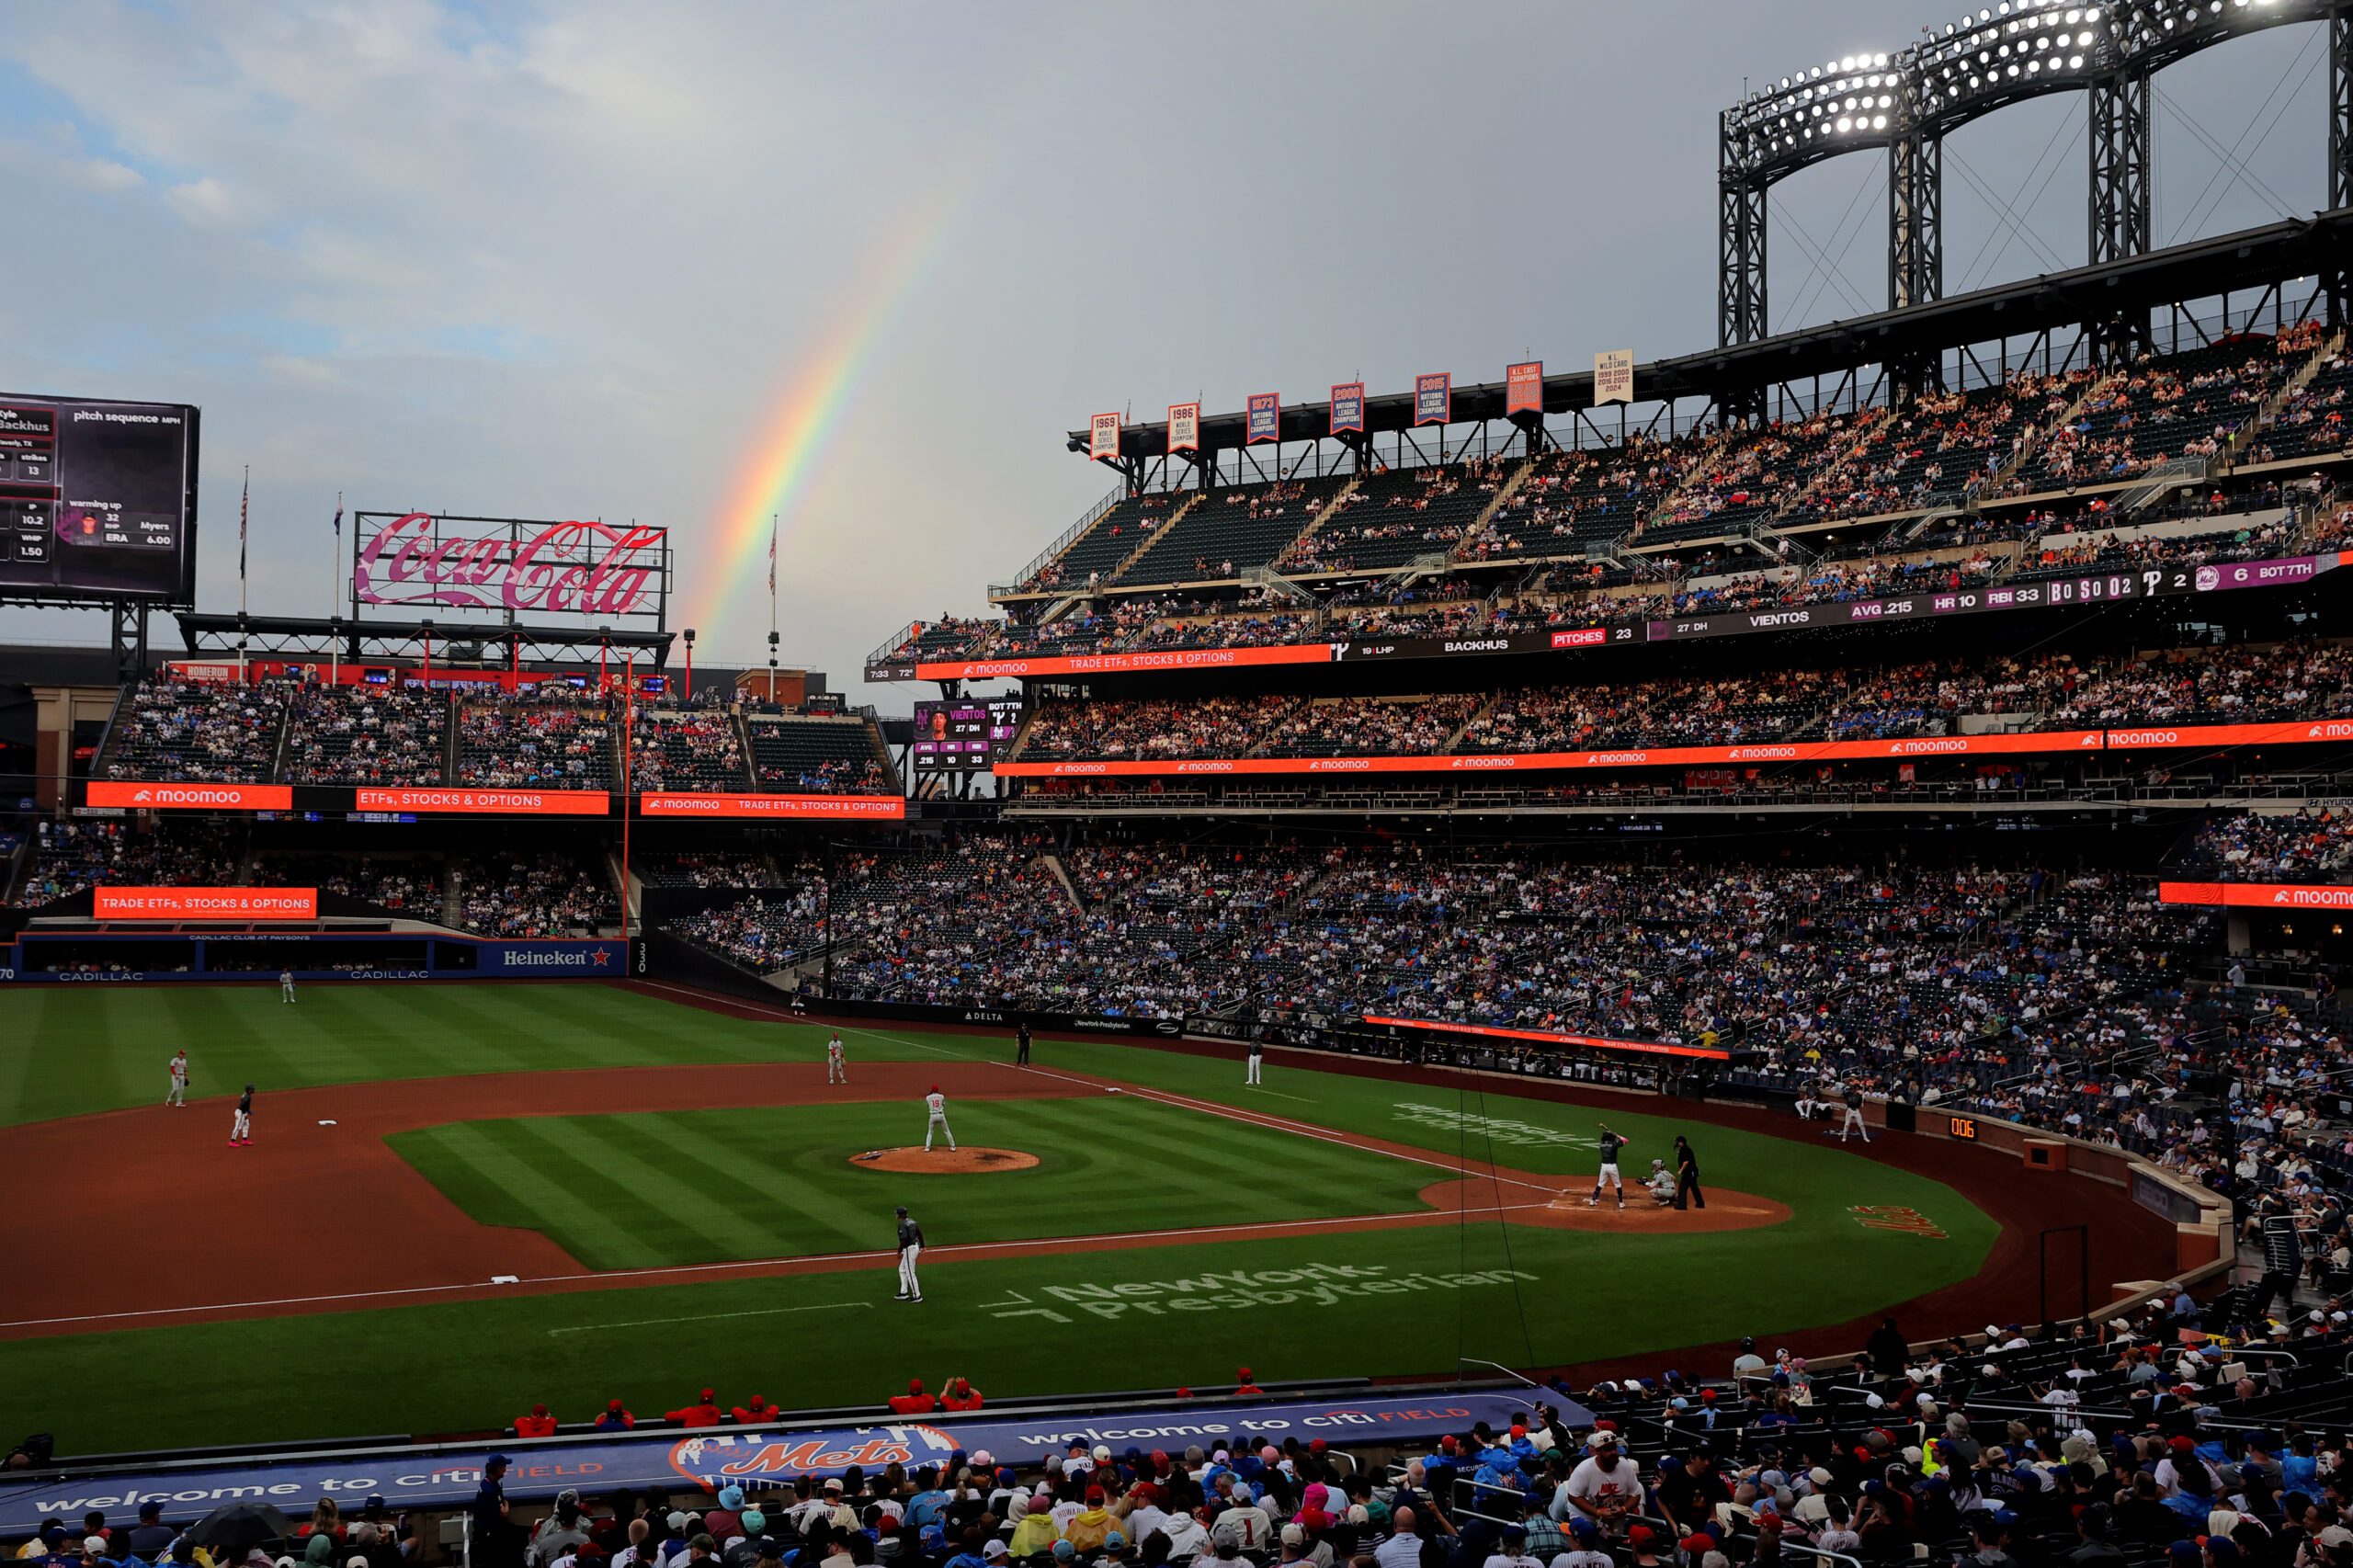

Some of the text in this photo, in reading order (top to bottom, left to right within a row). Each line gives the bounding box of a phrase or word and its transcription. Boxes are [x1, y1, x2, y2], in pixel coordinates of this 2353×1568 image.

[1421, 377, 1445, 392] 2015
[1335, 387, 1360, 401] 2000
[1252, 397, 1274, 410] 1973
[74, 410, 103, 422] pitch
[105, 414, 159, 424] sequence
[1173, 408, 1193, 419] 1986
[1096, 417, 1115, 428] 1969
[28, 466, 40, 475] 13
[70, 500, 122, 511] warming up
[22, 515, 44, 526] 10.2
[107, 513, 119, 522] 32
[141, 521, 169, 531] Myers
[22, 534, 42, 542] WHIP
[106, 533, 171, 544] ERA 6.00
[20, 546, 42, 556] 1.50
[355, 512, 669, 613] Coca-Cola
[2234, 568, 2248, 581] 6
[2259, 563, 2313, 579] BOT 7TH
[2173, 574, 2187, 588] 2
[1934, 596, 1976, 608] HR 10
[1988, 588, 2040, 605] RBI 33
[1851, 601, 1913, 618] AVG .215
[1750, 612, 1809, 627] VIENTOS
[1677, 621, 1708, 632] 27 DH
[1554, 631, 1604, 645] PITCHES
[1616, 629, 1632, 640] 23
[1375, 645, 1395, 654] LHP
[1445, 640, 1509, 653] BACKHUS
[1070, 653, 1234, 669] TRADE ETFs, STOCKS & OPTIONS
[188, 665, 228, 676] HOMERUN
[870, 669, 890, 678] 7:33
[977, 662, 1028, 675] moomoo
[989, 702, 1005, 710] BOT
[950, 710, 985, 720] VIENTOS
[956, 724, 965, 733] 27
[2327, 723, 2353, 737] mo
[2100, 732, 2177, 744] moomoo
[1743, 746, 1796, 758] moomoo
[1906, 740, 1967, 753] moomoo
[1322, 759, 1370, 768] moomoo
[1465, 757, 1515, 767] moomoo
[1599, 752, 1646, 763] moomoo
[1064, 765, 1106, 774] moomoo
[1188, 762, 1233, 771] moomoo
[156, 790, 241, 803] moomoo
[360, 792, 542, 807] ETFs, STOCKS & OPTIONS
[664, 800, 720, 810] moomoo
[739, 801, 897, 812] TRADE ETFs, STOCKS & OPTIONS
[103, 898, 311, 910] TRADE ETFs, STOCKS & OPTIONS
[504, 950, 585, 966] Heineken
[59, 972, 143, 982] CADILLAC
[351, 971, 428, 979] CADILLAC
[974, 1012, 1003, 1022] DELTA
[1952, 1118, 1974, 1138] 006
[1077, 1267, 1540, 1319] Presbyterian
[1018, 1423, 1230, 1445] welcome
[1239, 1419, 1290, 1431] to
[1378, 1408, 1471, 1422] FIELD
[721, 1438, 914, 1474] Mets
[1601, 1483, 1620, 1494] NIKE
[35, 1482, 301, 1513] welcome
[320, 1477, 378, 1491] to
[1245, 1518, 1254, 1545] 1
